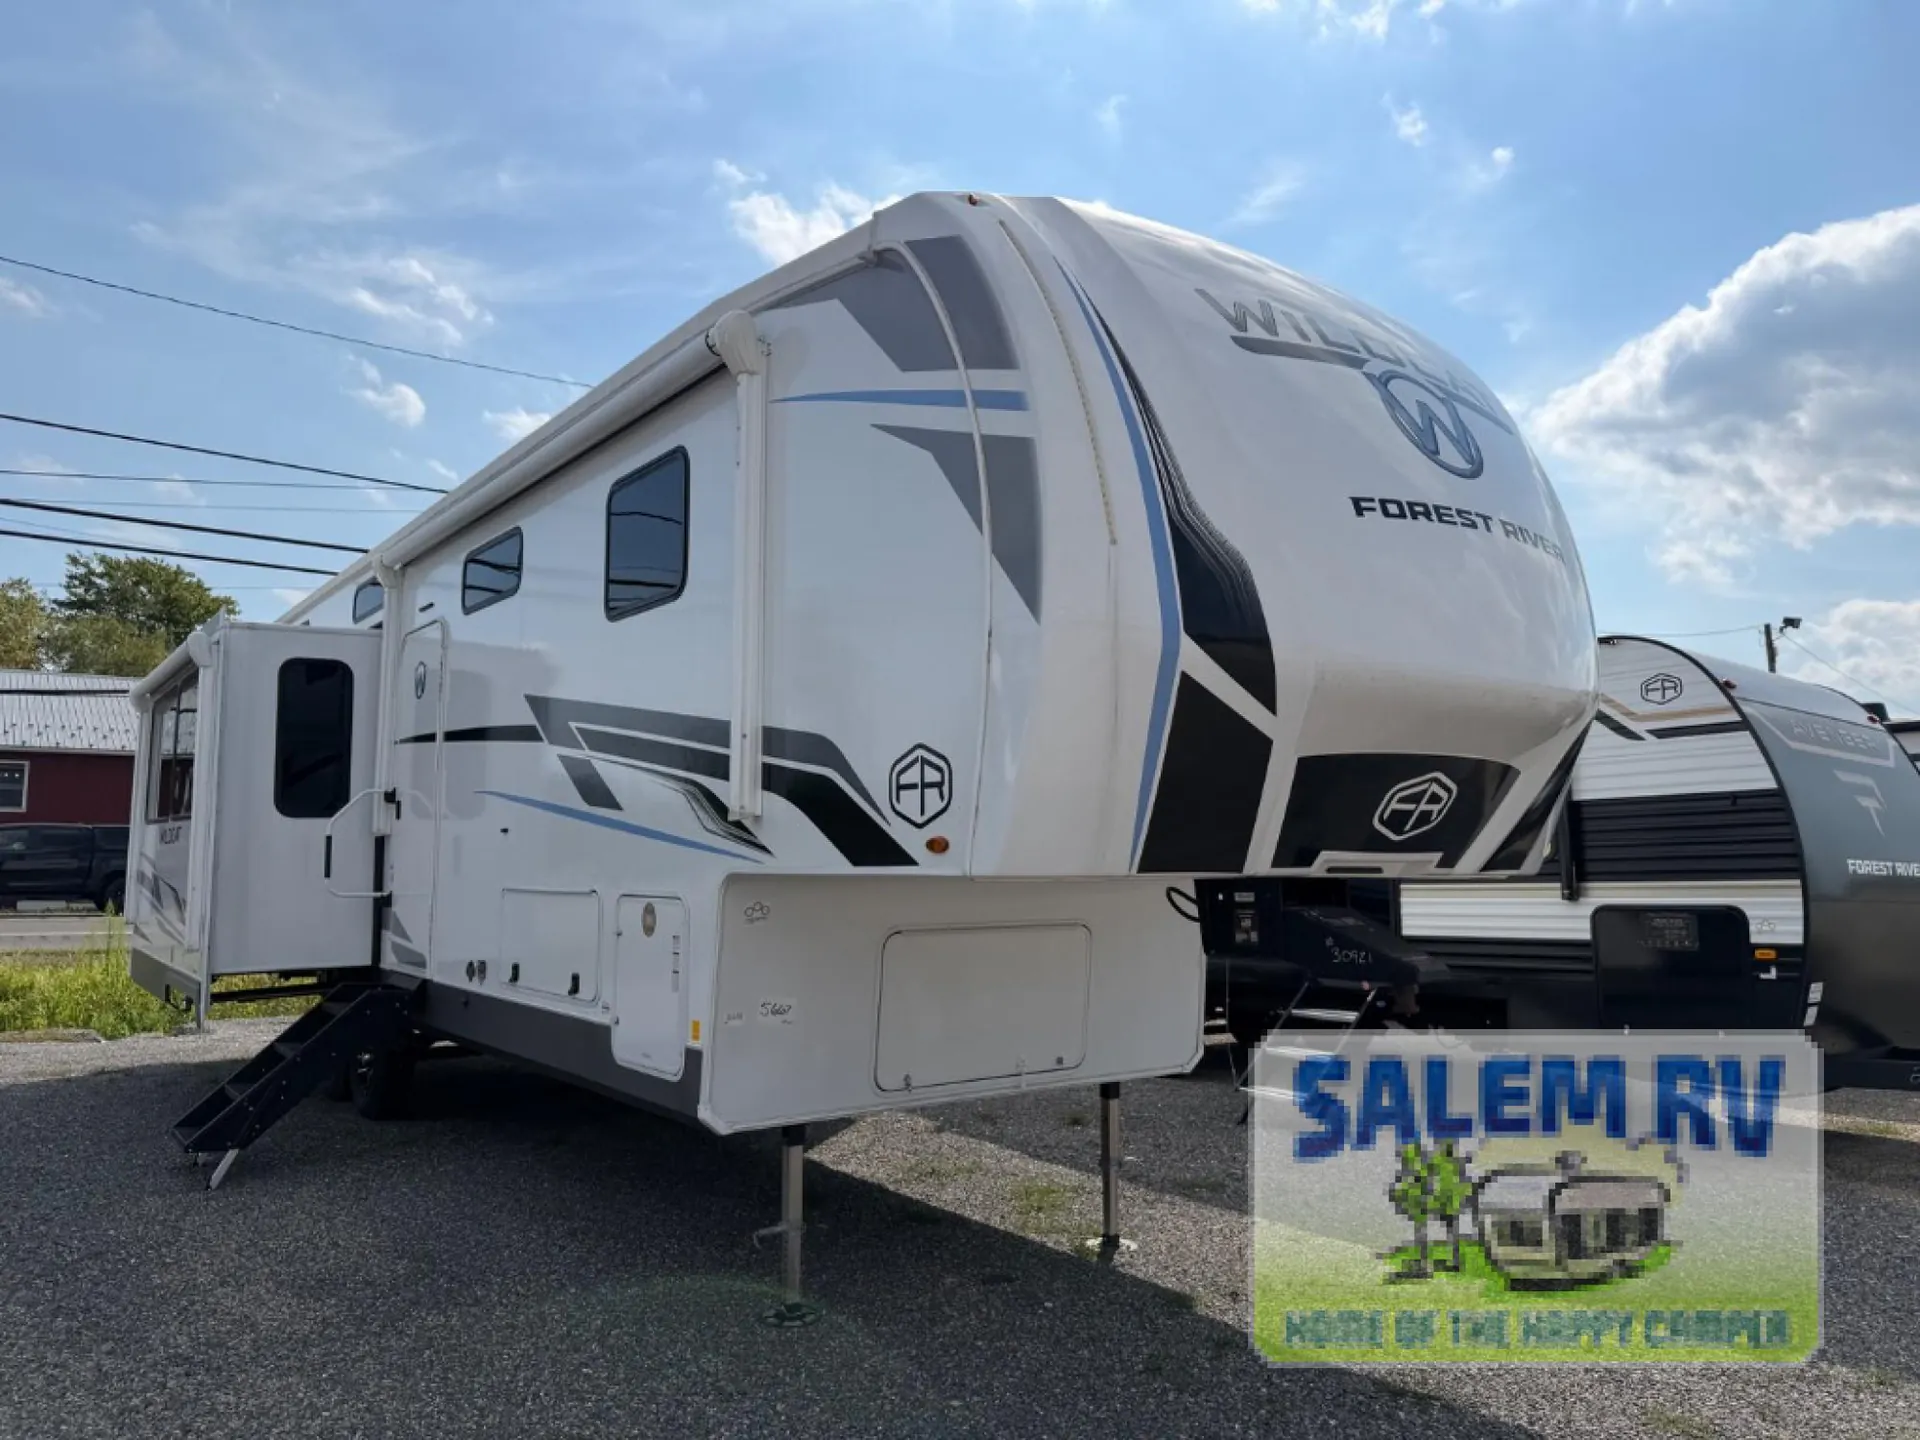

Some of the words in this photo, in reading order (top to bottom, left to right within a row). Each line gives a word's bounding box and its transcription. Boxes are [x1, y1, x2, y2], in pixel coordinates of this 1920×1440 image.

[1348, 496, 1494, 533] FOREST
[1498, 517, 1567, 566] RIVER
[1846, 858, 1893, 876] FOREST
